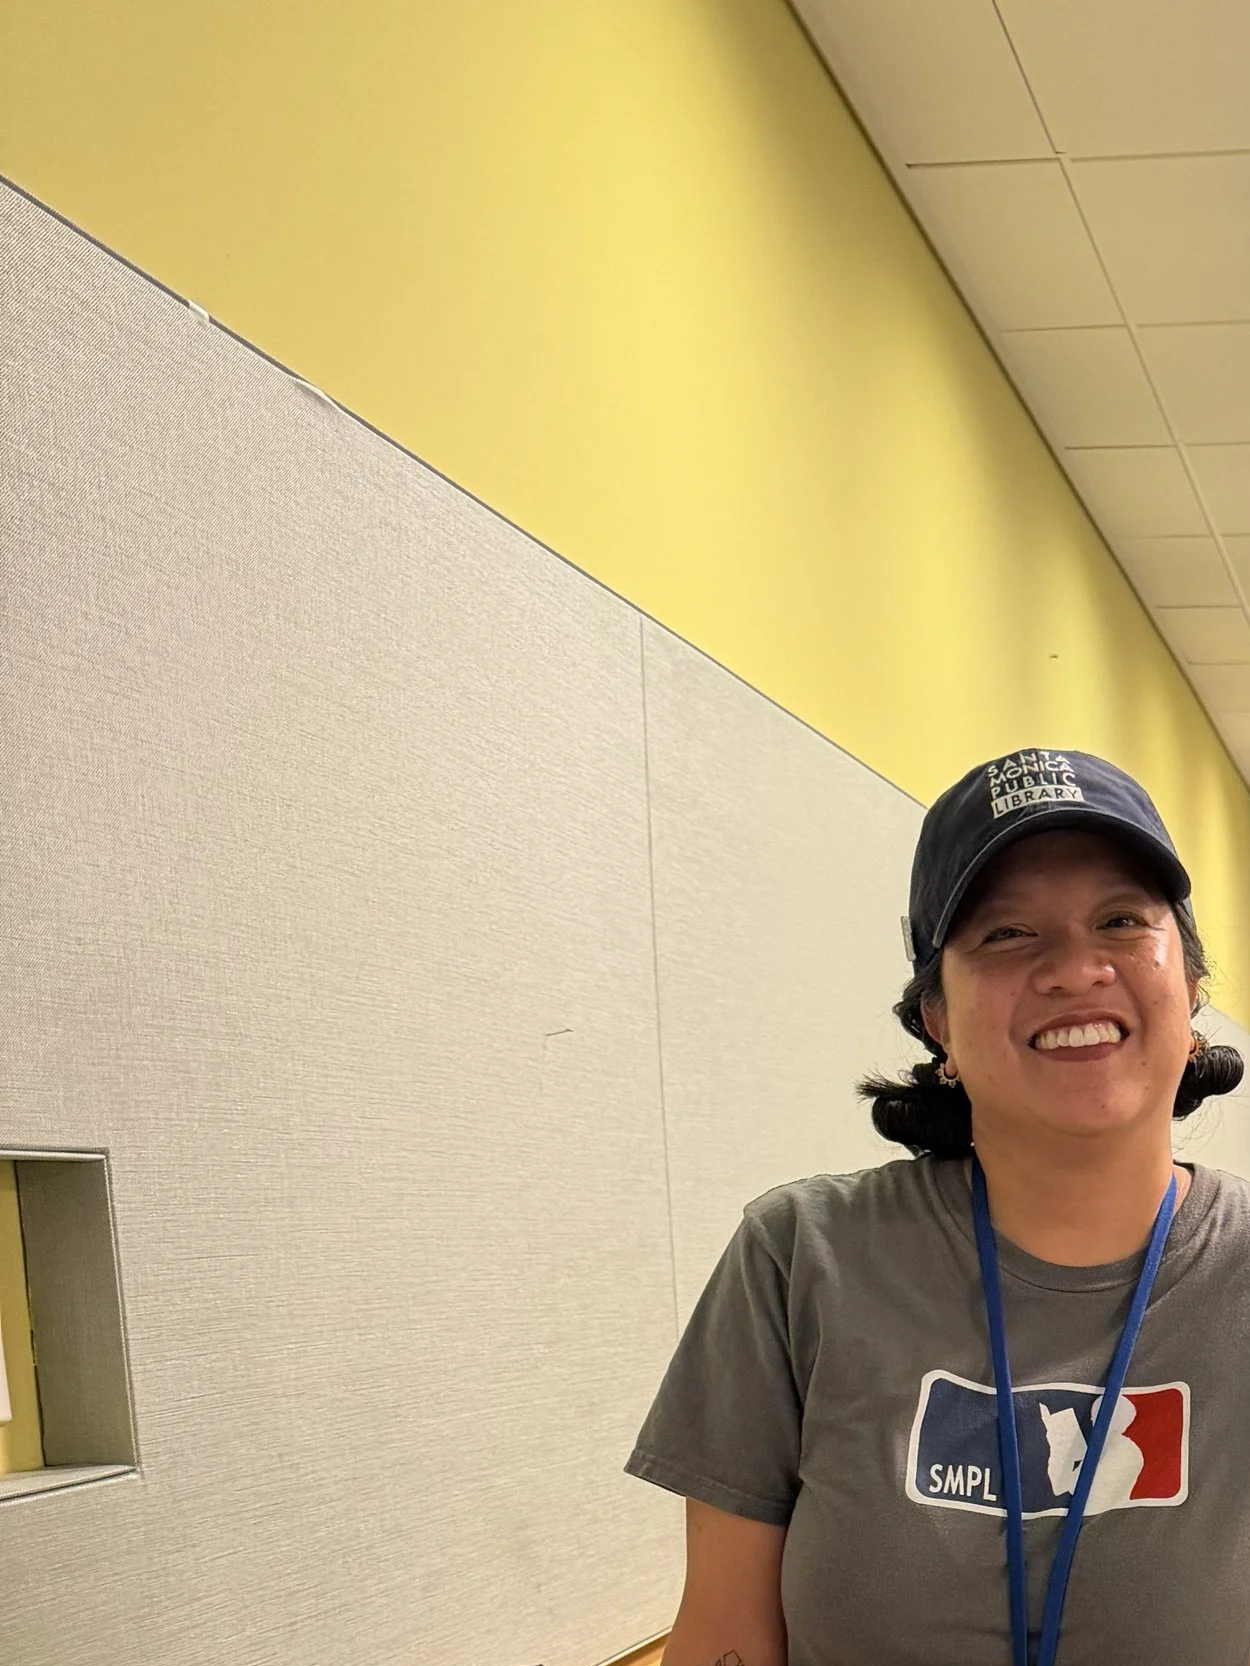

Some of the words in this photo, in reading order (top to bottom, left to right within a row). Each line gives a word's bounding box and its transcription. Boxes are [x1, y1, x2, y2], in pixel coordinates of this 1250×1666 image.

[988, 751, 1070, 776] SANTA
[989, 762, 1074, 786] MONICA
[991, 773, 1075, 799] PUBLIC
[995, 789, 1078, 816] LIBRARY
[929, 1464, 997, 1501] SMPL
